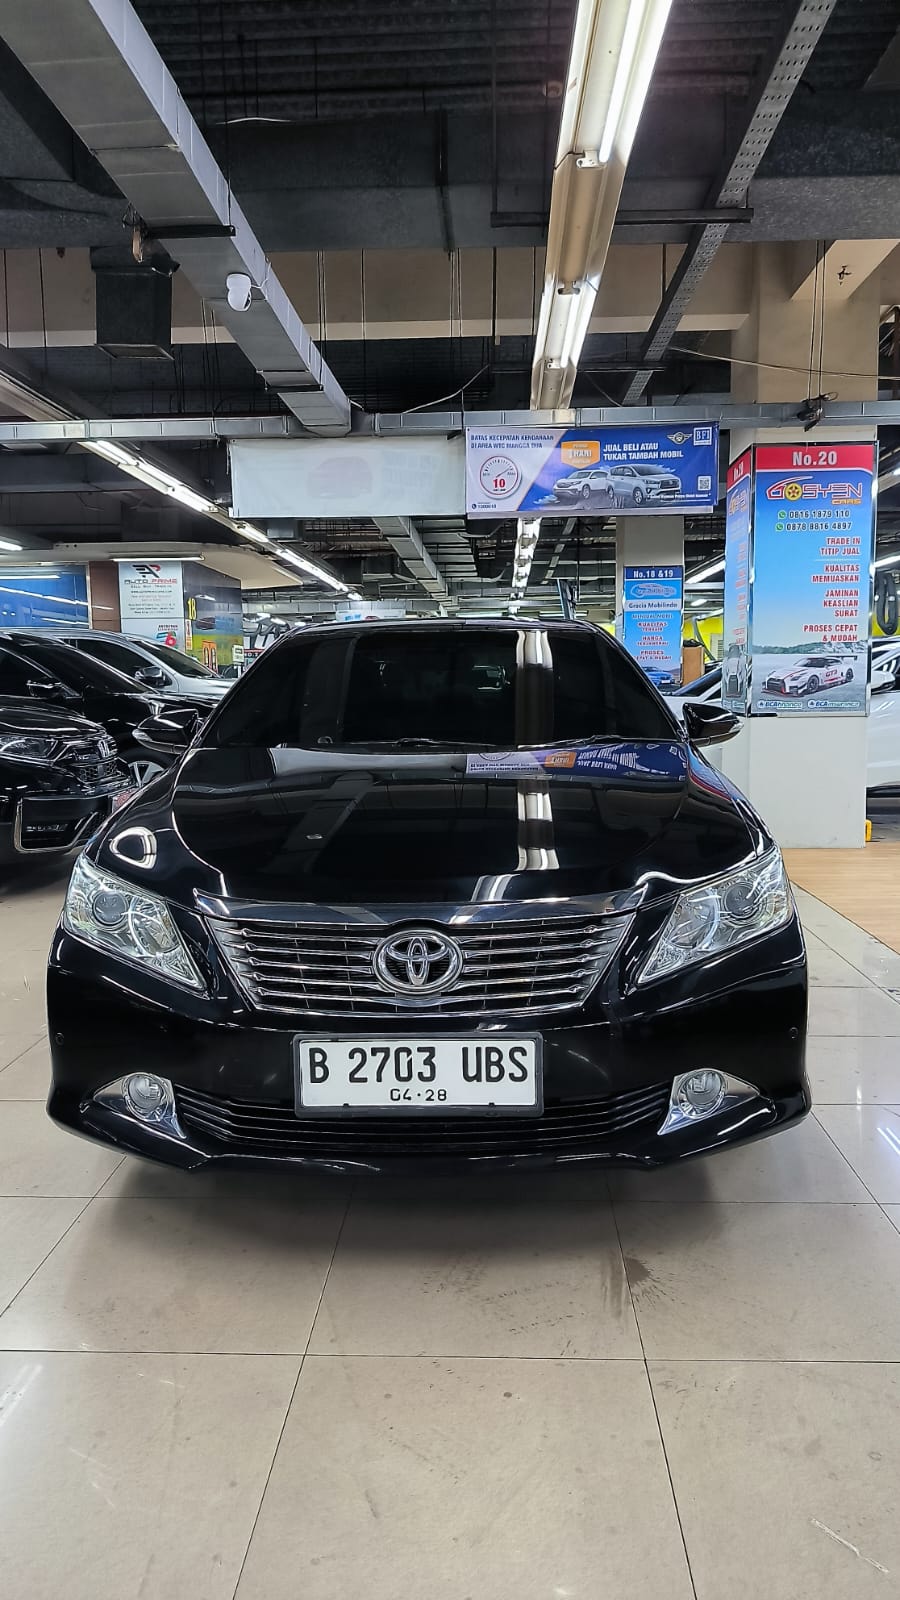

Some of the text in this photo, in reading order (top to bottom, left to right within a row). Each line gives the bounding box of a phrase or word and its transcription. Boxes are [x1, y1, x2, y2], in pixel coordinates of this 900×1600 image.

[696, 430, 710, 440] BFI
[603, 442, 659, 452] JUAL BELI ATAU
[603, 450, 685, 461] TUKAR TAMBAH MOBIL
[792, 450, 837, 466] No.20
[493, 478, 506, 488] 10
[789, 510, 850, 519] 0816 1879 110
[786, 522, 852, 531] 0878 8816 4897
[826, 537, 861, 545] TRADE IN
[820, 547, 860, 555] TITIP JUAL
[825, 564, 860, 572] KUALITAS
[633, 570, 656, 579] No.18
[812, 575, 859, 583] MEMUASKAN
[825, 589, 859, 597] JAMINAN
[648, 601, 678, 609] Mobilindo
[823, 599, 859, 607] KEASLIAN
[187, 597, 198, 620] 18
[834, 609, 858, 617] SURAT
[803, 624, 858, 632] PROSES CEPAT
[822, 634, 858, 642] & MUDAH
[308, 1046, 529, 1084] B 2703 UBS
